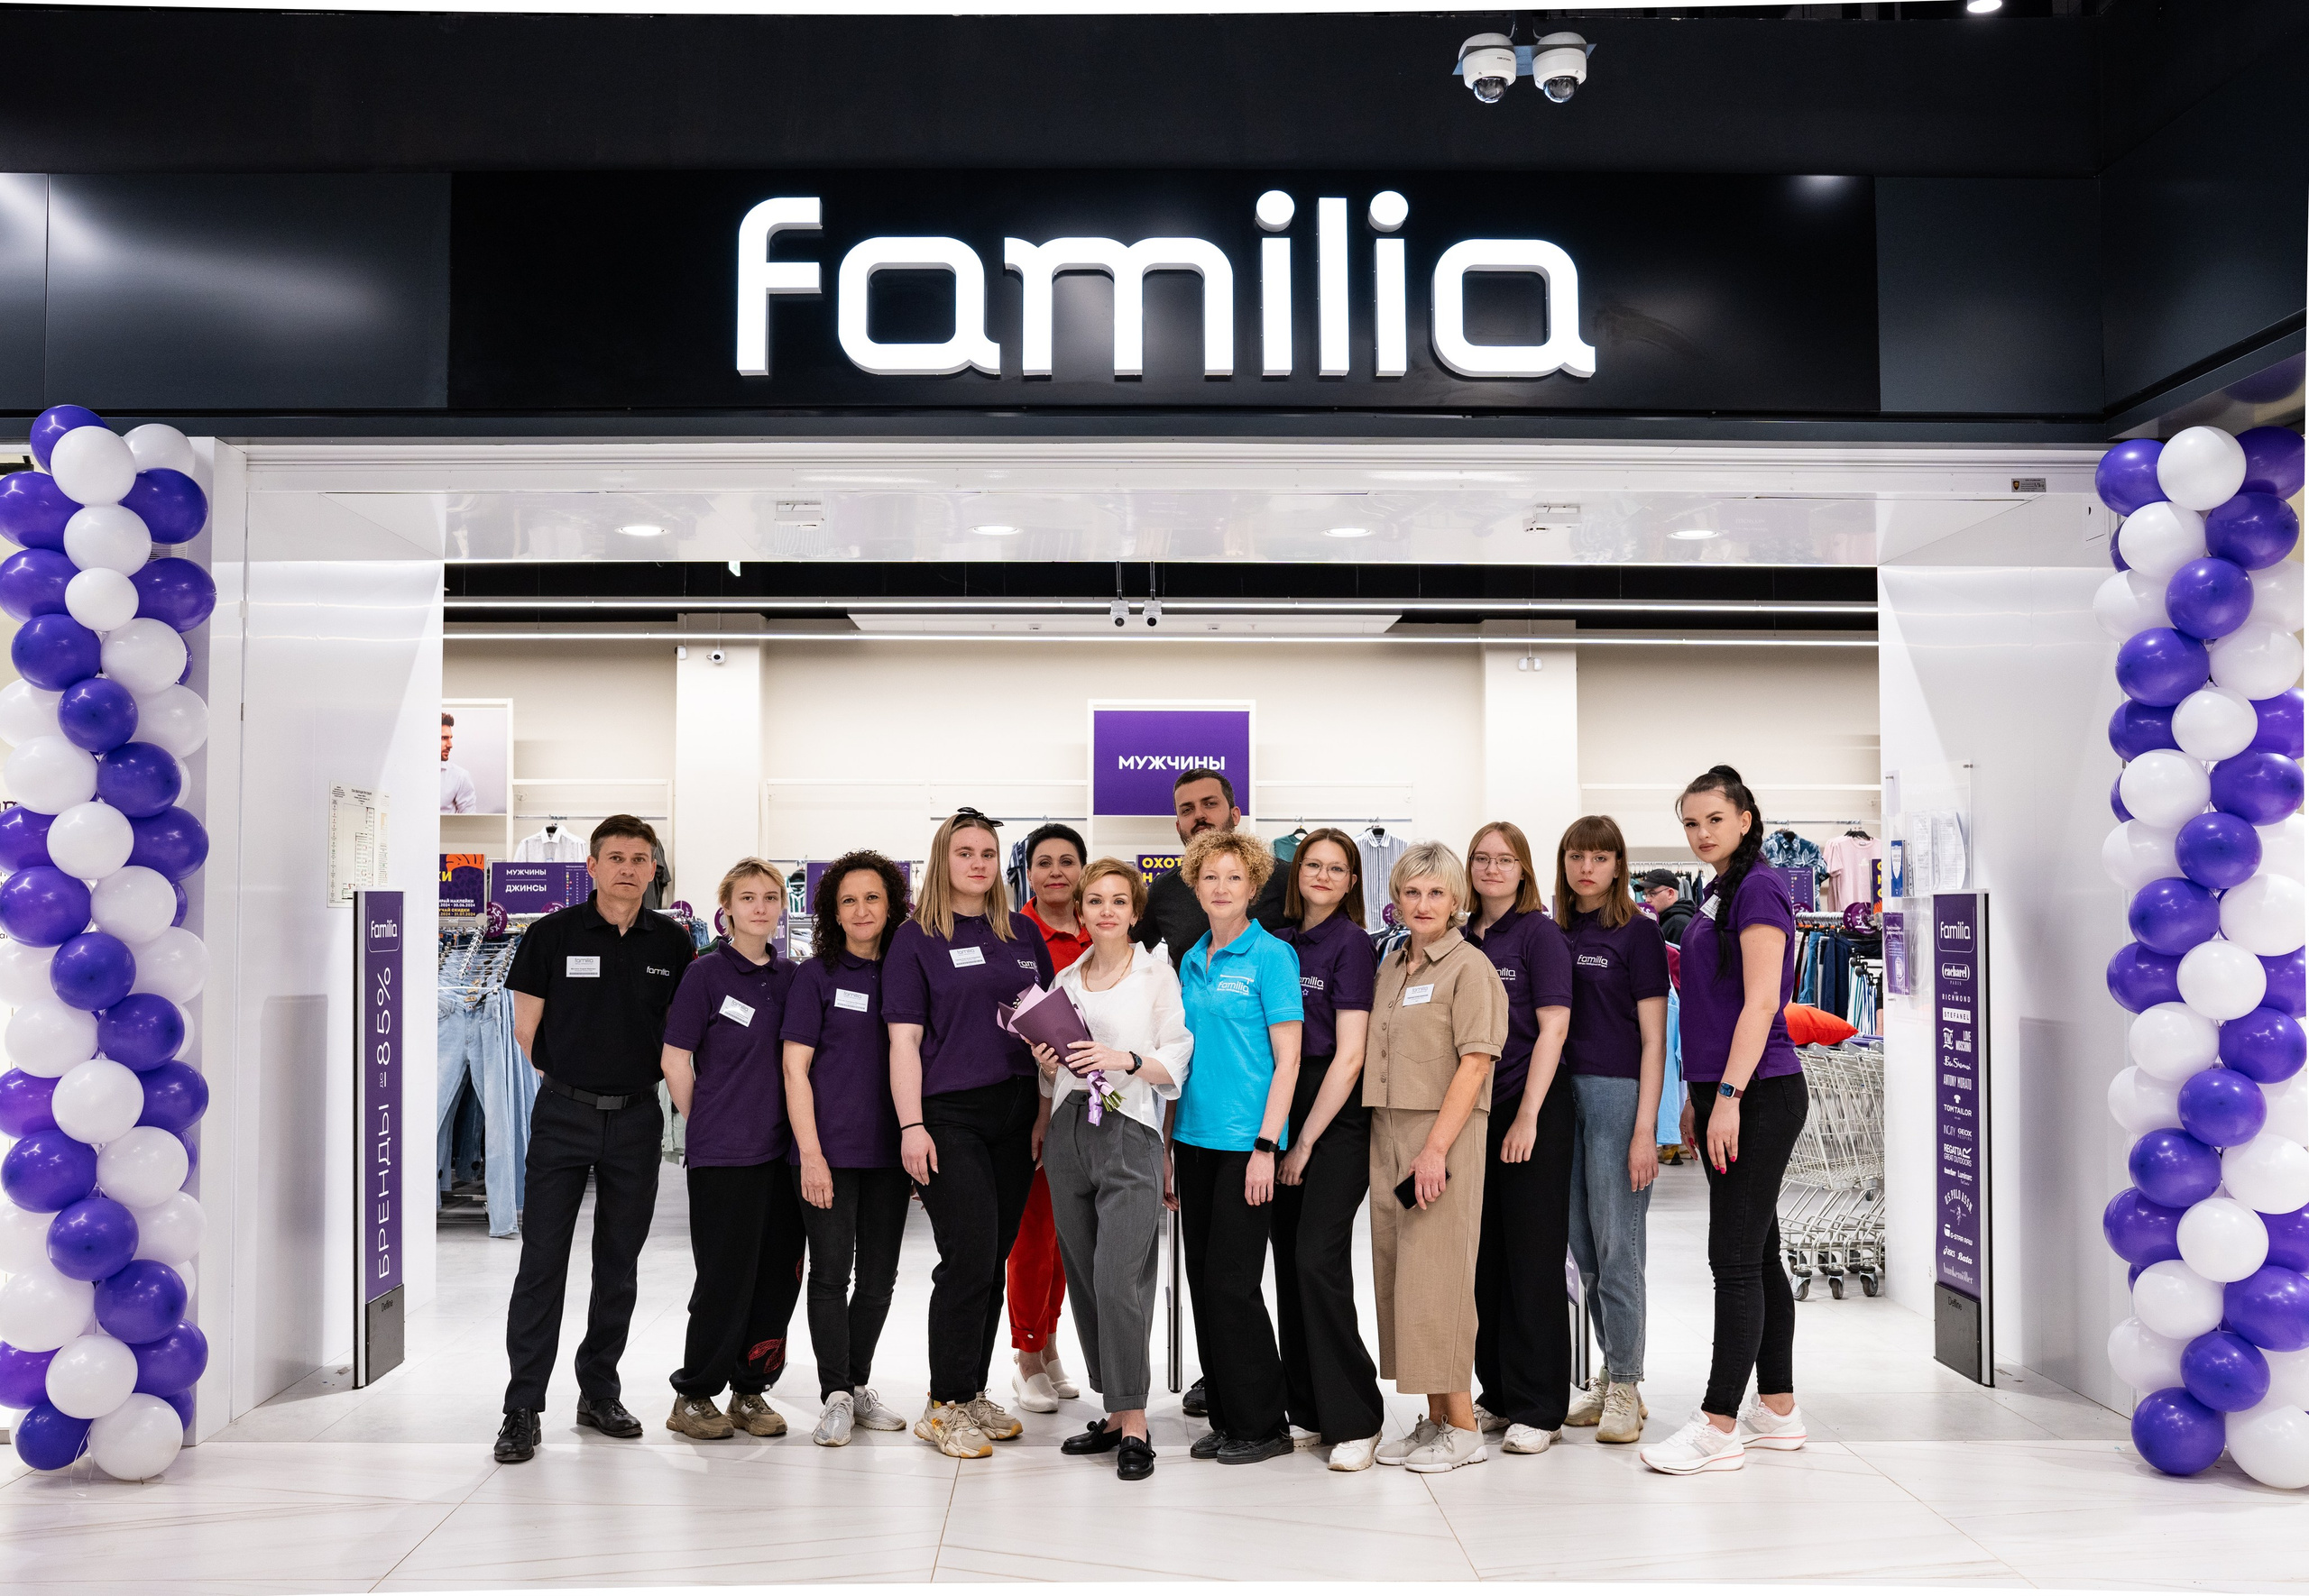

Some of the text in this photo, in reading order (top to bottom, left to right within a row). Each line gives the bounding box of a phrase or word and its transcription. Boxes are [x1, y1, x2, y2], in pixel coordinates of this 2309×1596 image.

[735, 189, 1596, 378] familia
[1118, 756, 1225, 770] МУЖЧИНЫ
[1142, 858, 1182, 868] ОХОТ
[506, 868, 547, 876] МУЖЧИНЫ
[505, 884, 547, 893] ДЖИНСЫ
[371, 920, 398, 939] familia
[1940, 921, 1971, 940] familia
[1578, 955, 1608, 966] familia
[646, 966, 669, 977] familia
[1944, 965, 1967, 978] cacharel
[1218, 980, 1249, 993] familia
[1300, 976, 1324, 987] amilia
[1942, 993, 1971, 1003] RICHMOND
[1944, 1011, 1969, 1021] STEFANEL
[1944, 1104, 1973, 1117] TOM TAILOR
[1957, 1128, 1972, 1137] GEOX
[1944, 1143, 1963, 1157] REGATTA
[378, 1104, 391, 1280] БРЕНДЫ
[1957, 1252, 1973, 1265] Bata
